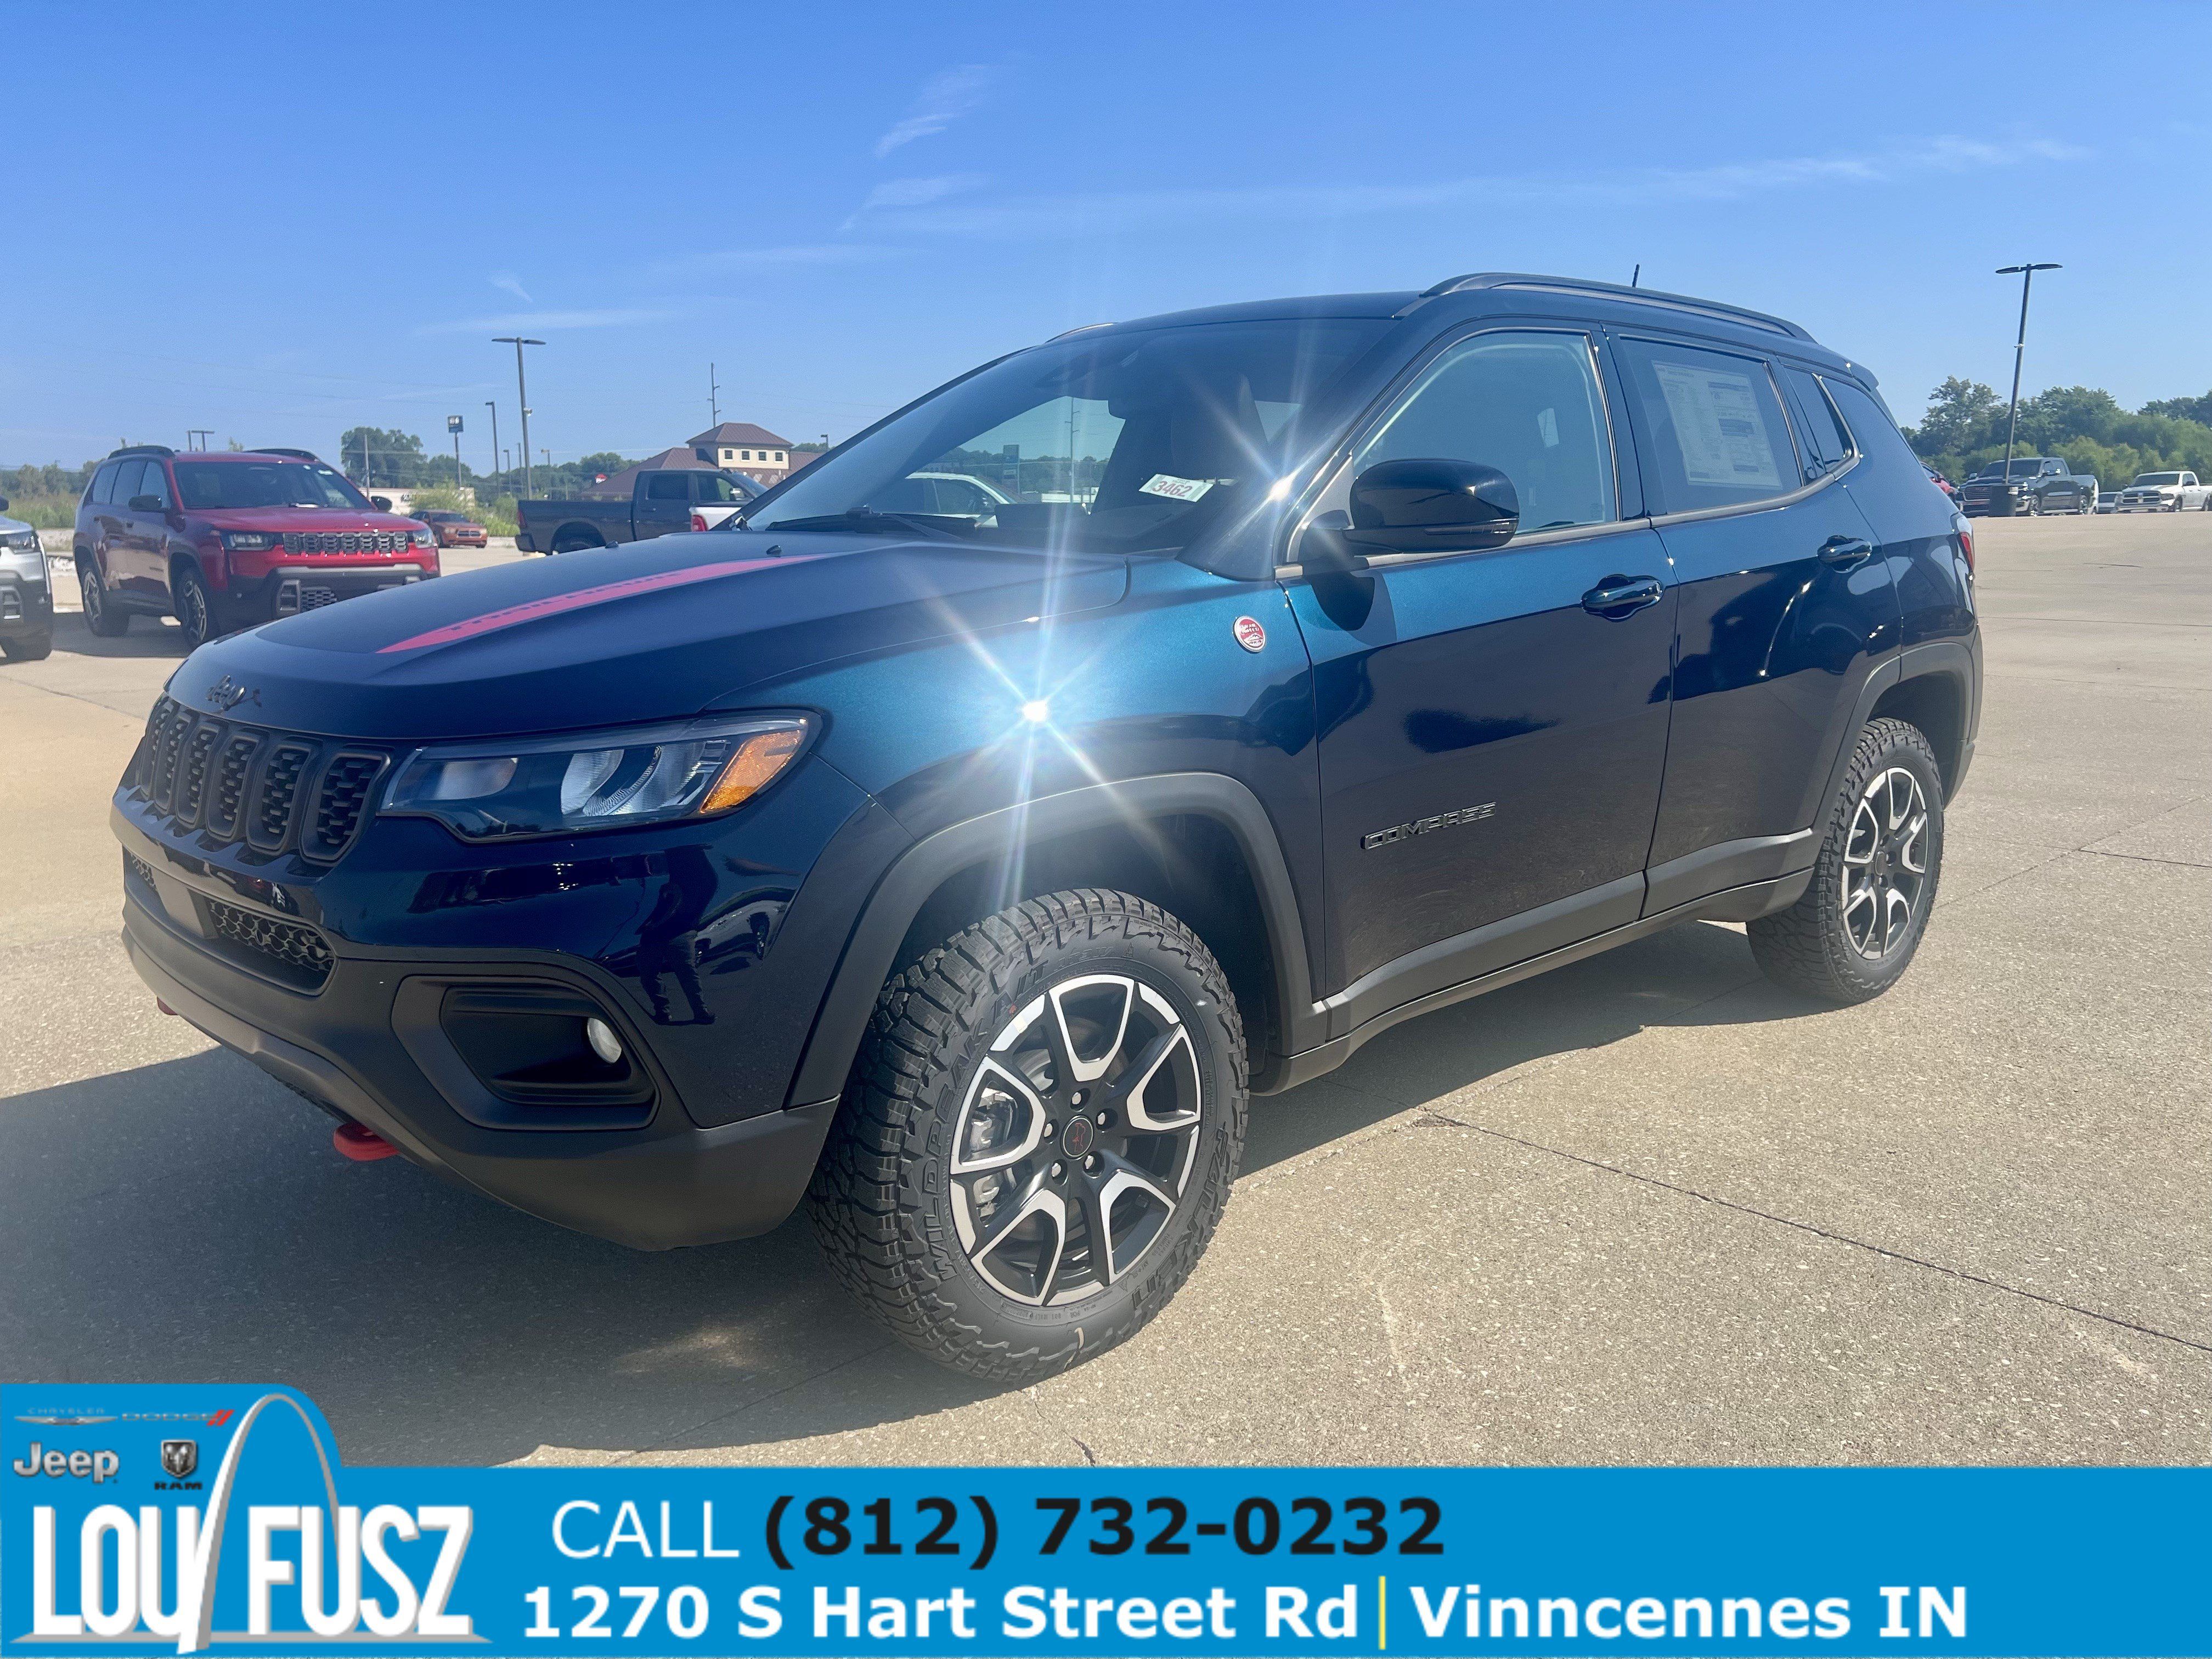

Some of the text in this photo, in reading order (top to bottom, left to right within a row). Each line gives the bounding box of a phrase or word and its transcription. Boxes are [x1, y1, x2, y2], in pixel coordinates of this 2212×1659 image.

[1153, 481, 1193, 496] 3462
[1361, 802, 1497, 850] COMPASS
[923, 1018, 988, 1280] WILDPEAK
